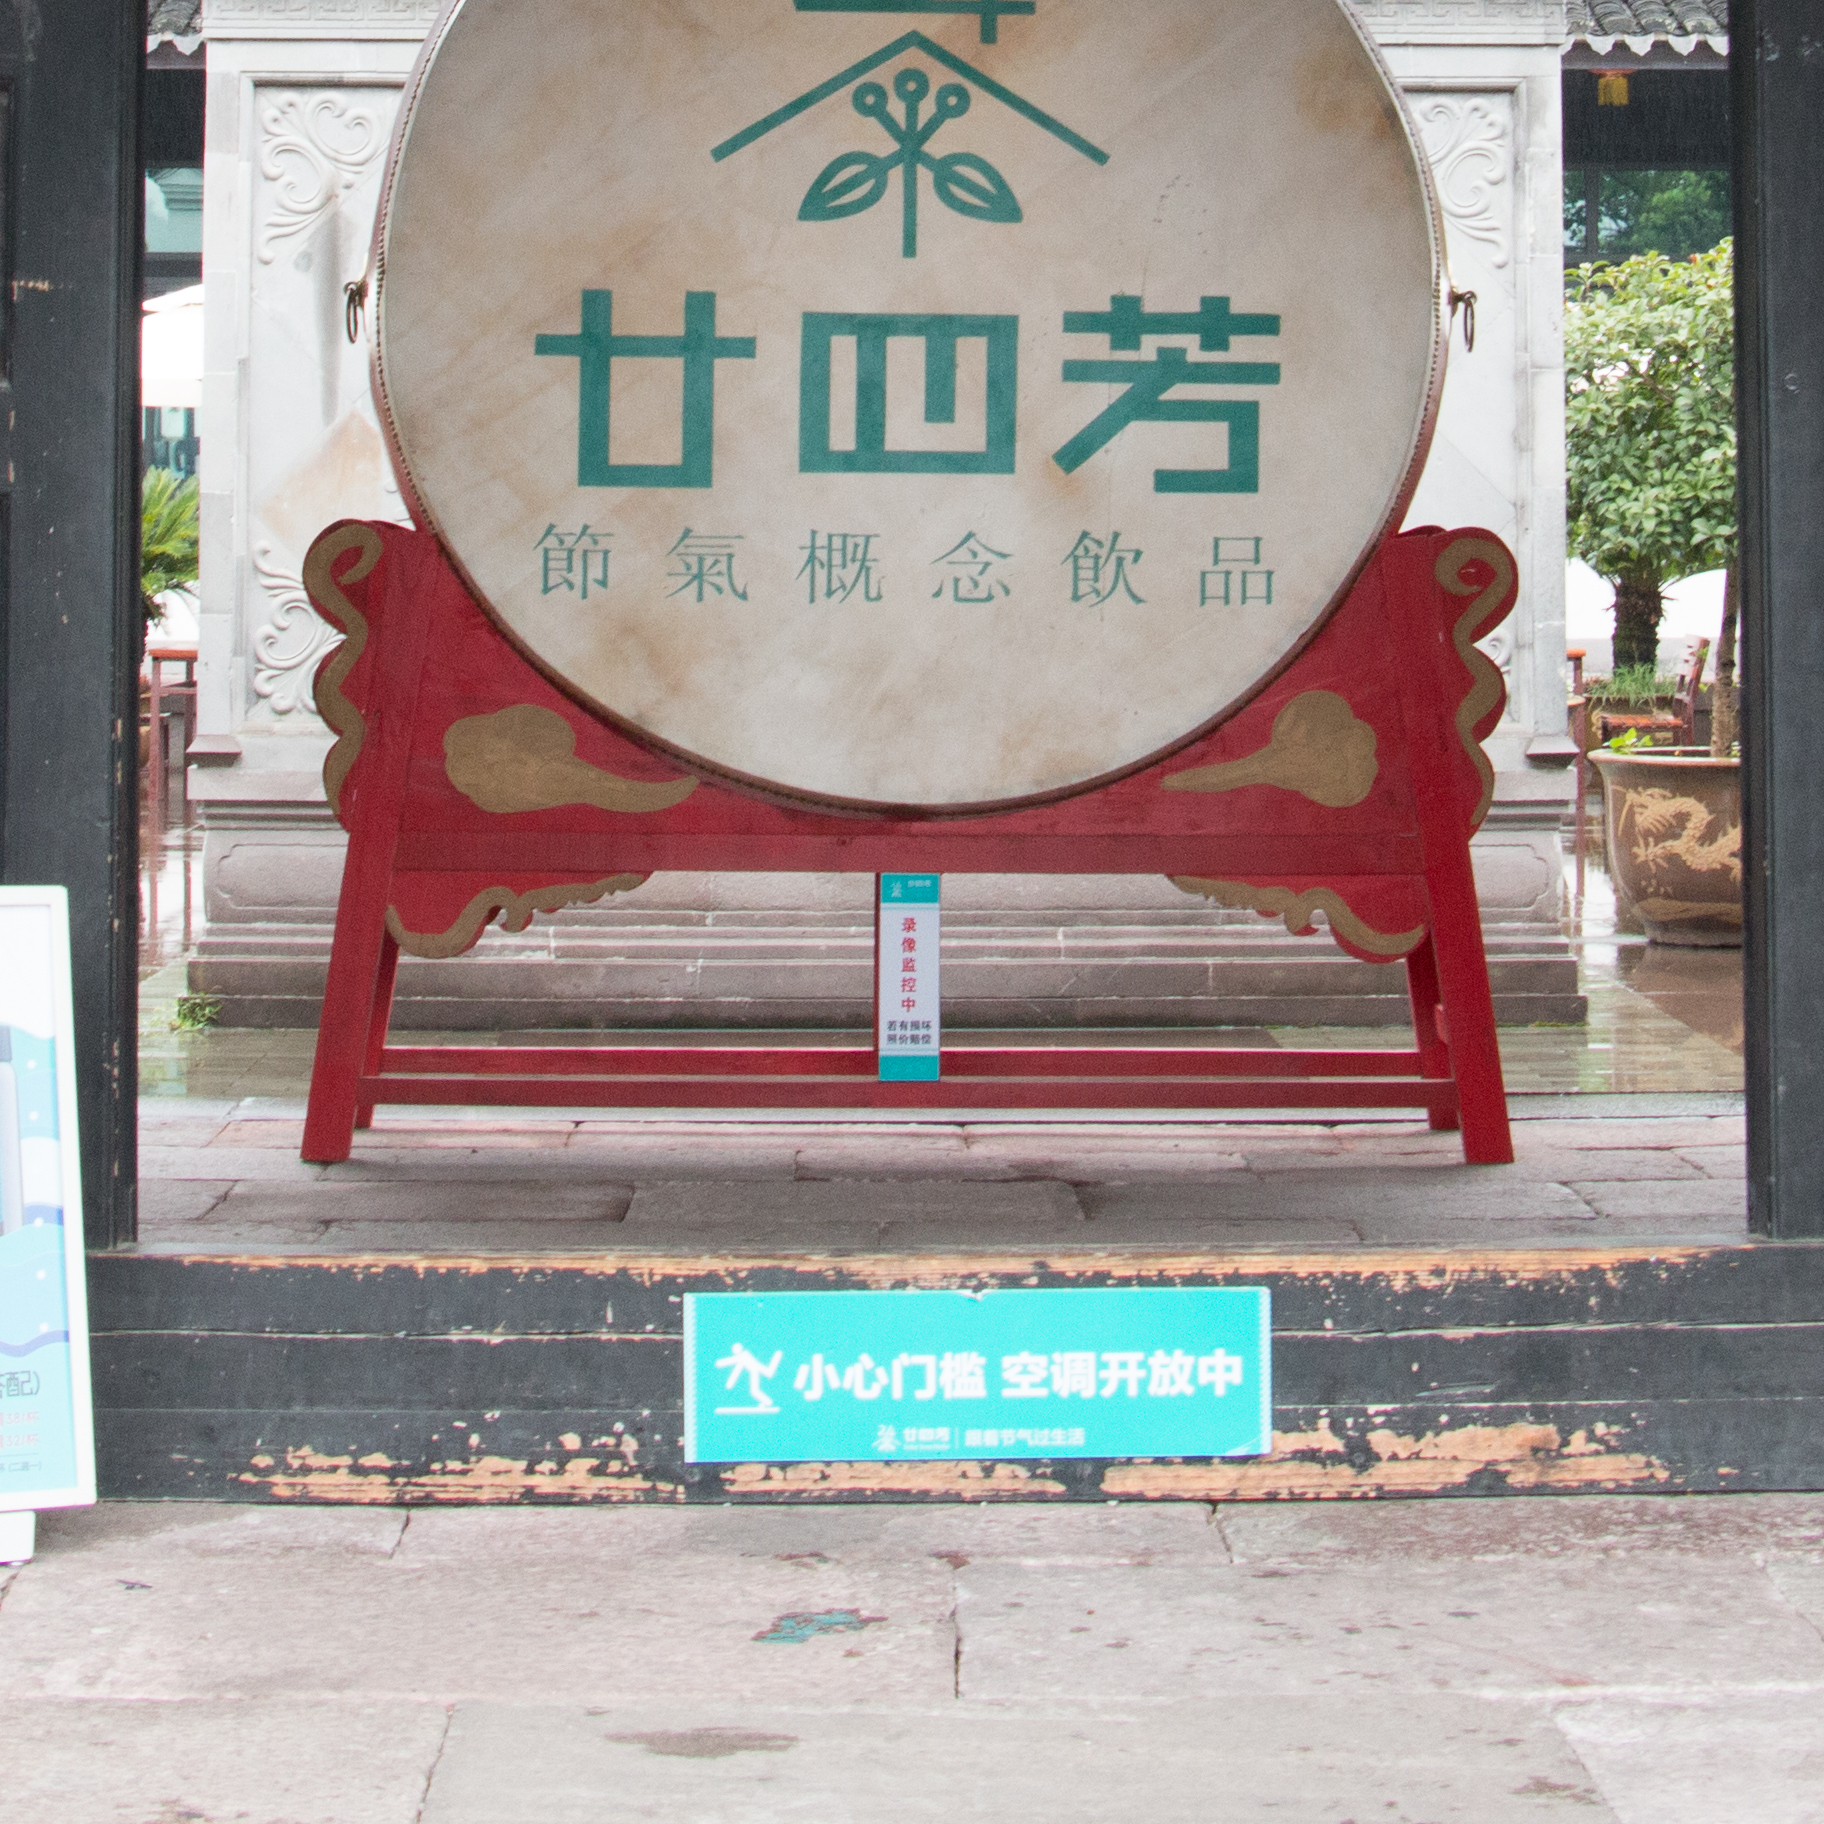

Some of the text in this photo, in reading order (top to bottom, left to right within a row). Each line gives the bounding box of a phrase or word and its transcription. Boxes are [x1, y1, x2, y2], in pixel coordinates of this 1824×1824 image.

[533, 288, 1281, 493] 廿四芳
[532, 523, 1277, 606] 節氣概念飲品
[900, 917, 917, 1013] 录像监控中
[886, 1033, 932, 1045] 照价赔偿
[887, 1019, 933, 1032] 若有损坏
[794, 1348, 1243, 1401] 小心门槛 空调开放中
